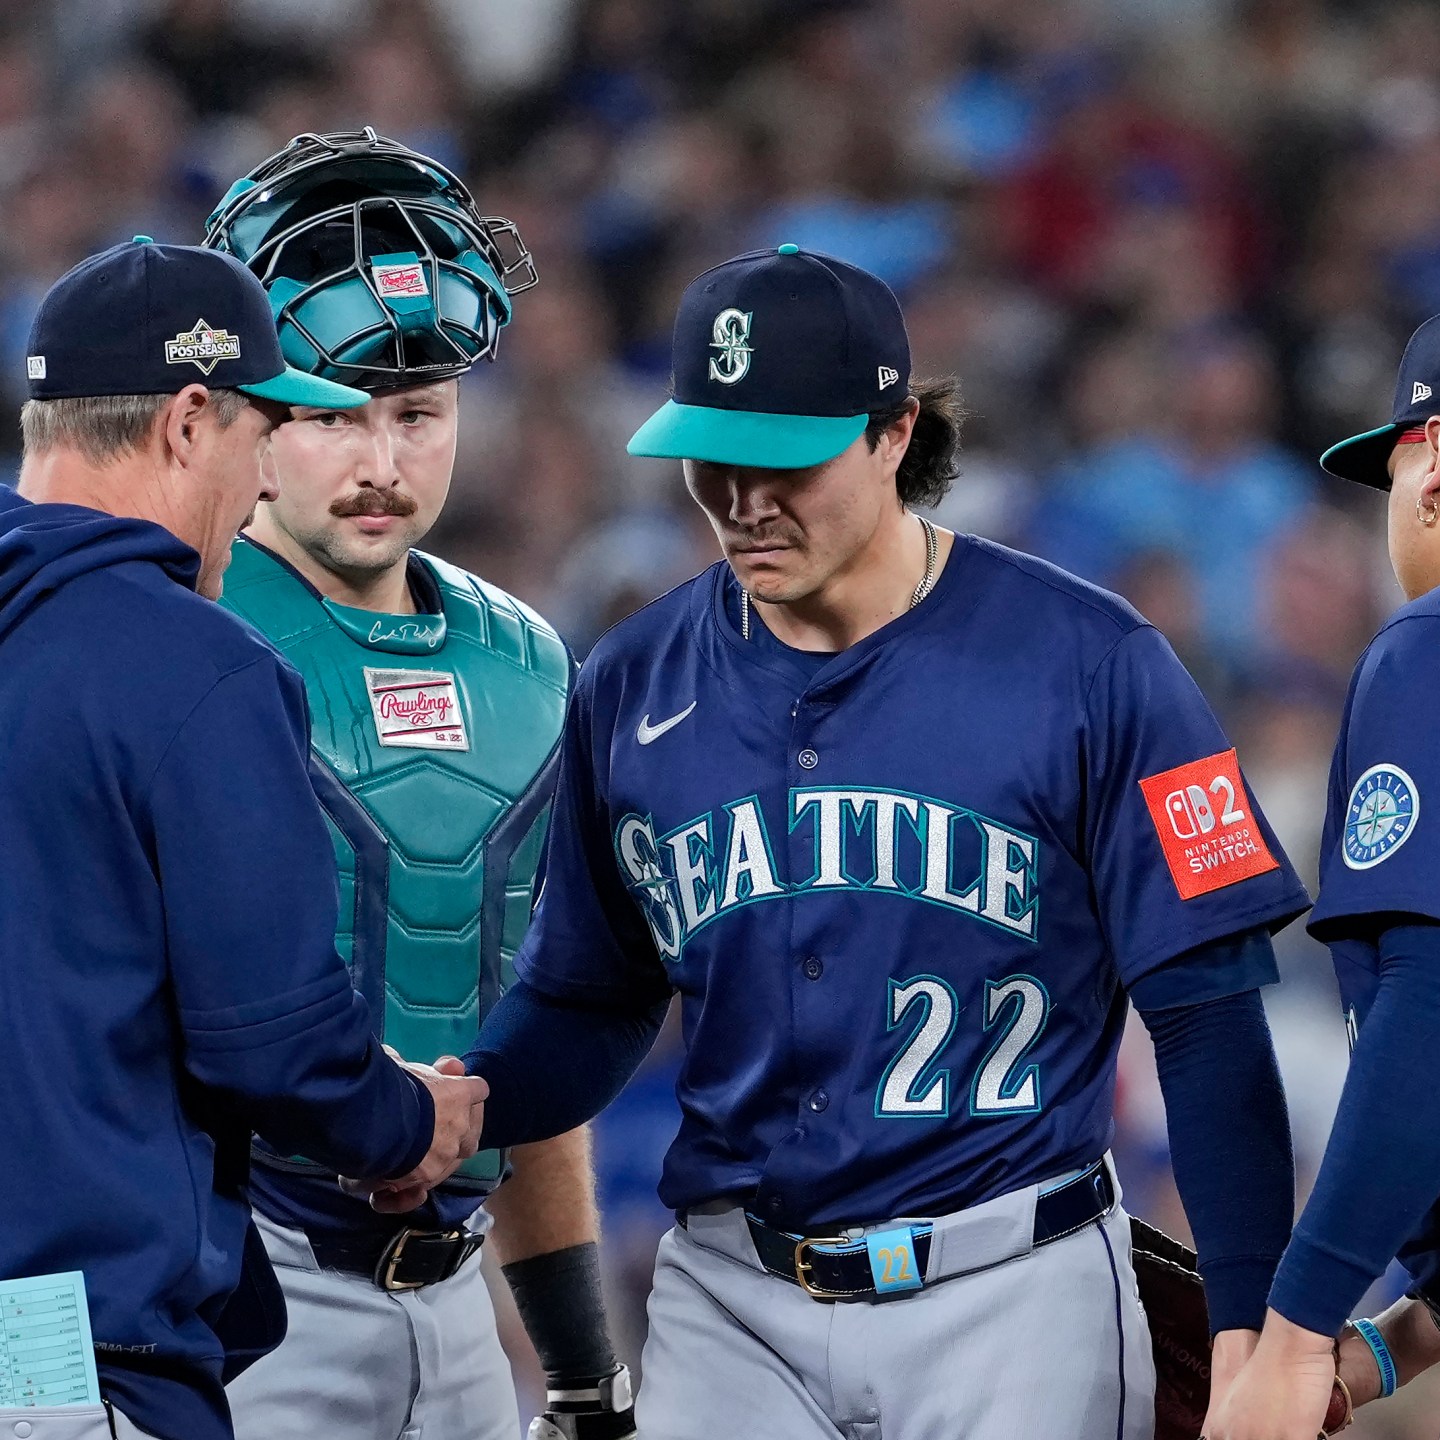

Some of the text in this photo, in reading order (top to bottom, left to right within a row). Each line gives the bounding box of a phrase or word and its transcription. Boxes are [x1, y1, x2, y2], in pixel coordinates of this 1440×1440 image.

[169, 342, 238, 359] POSTSEASON
[708, 308, 756, 387] S
[380, 691, 454, 721] Rawlings
[1352, 774, 1409, 814] SEATTLE
[1184, 828, 1251, 858] NINTENDO
[1189, 838, 1258, 873] SWITCH
[612, 785, 1040, 962] SEATTLE
[874, 973, 1056, 1118] 22
[877, 1246, 913, 1285] 22
